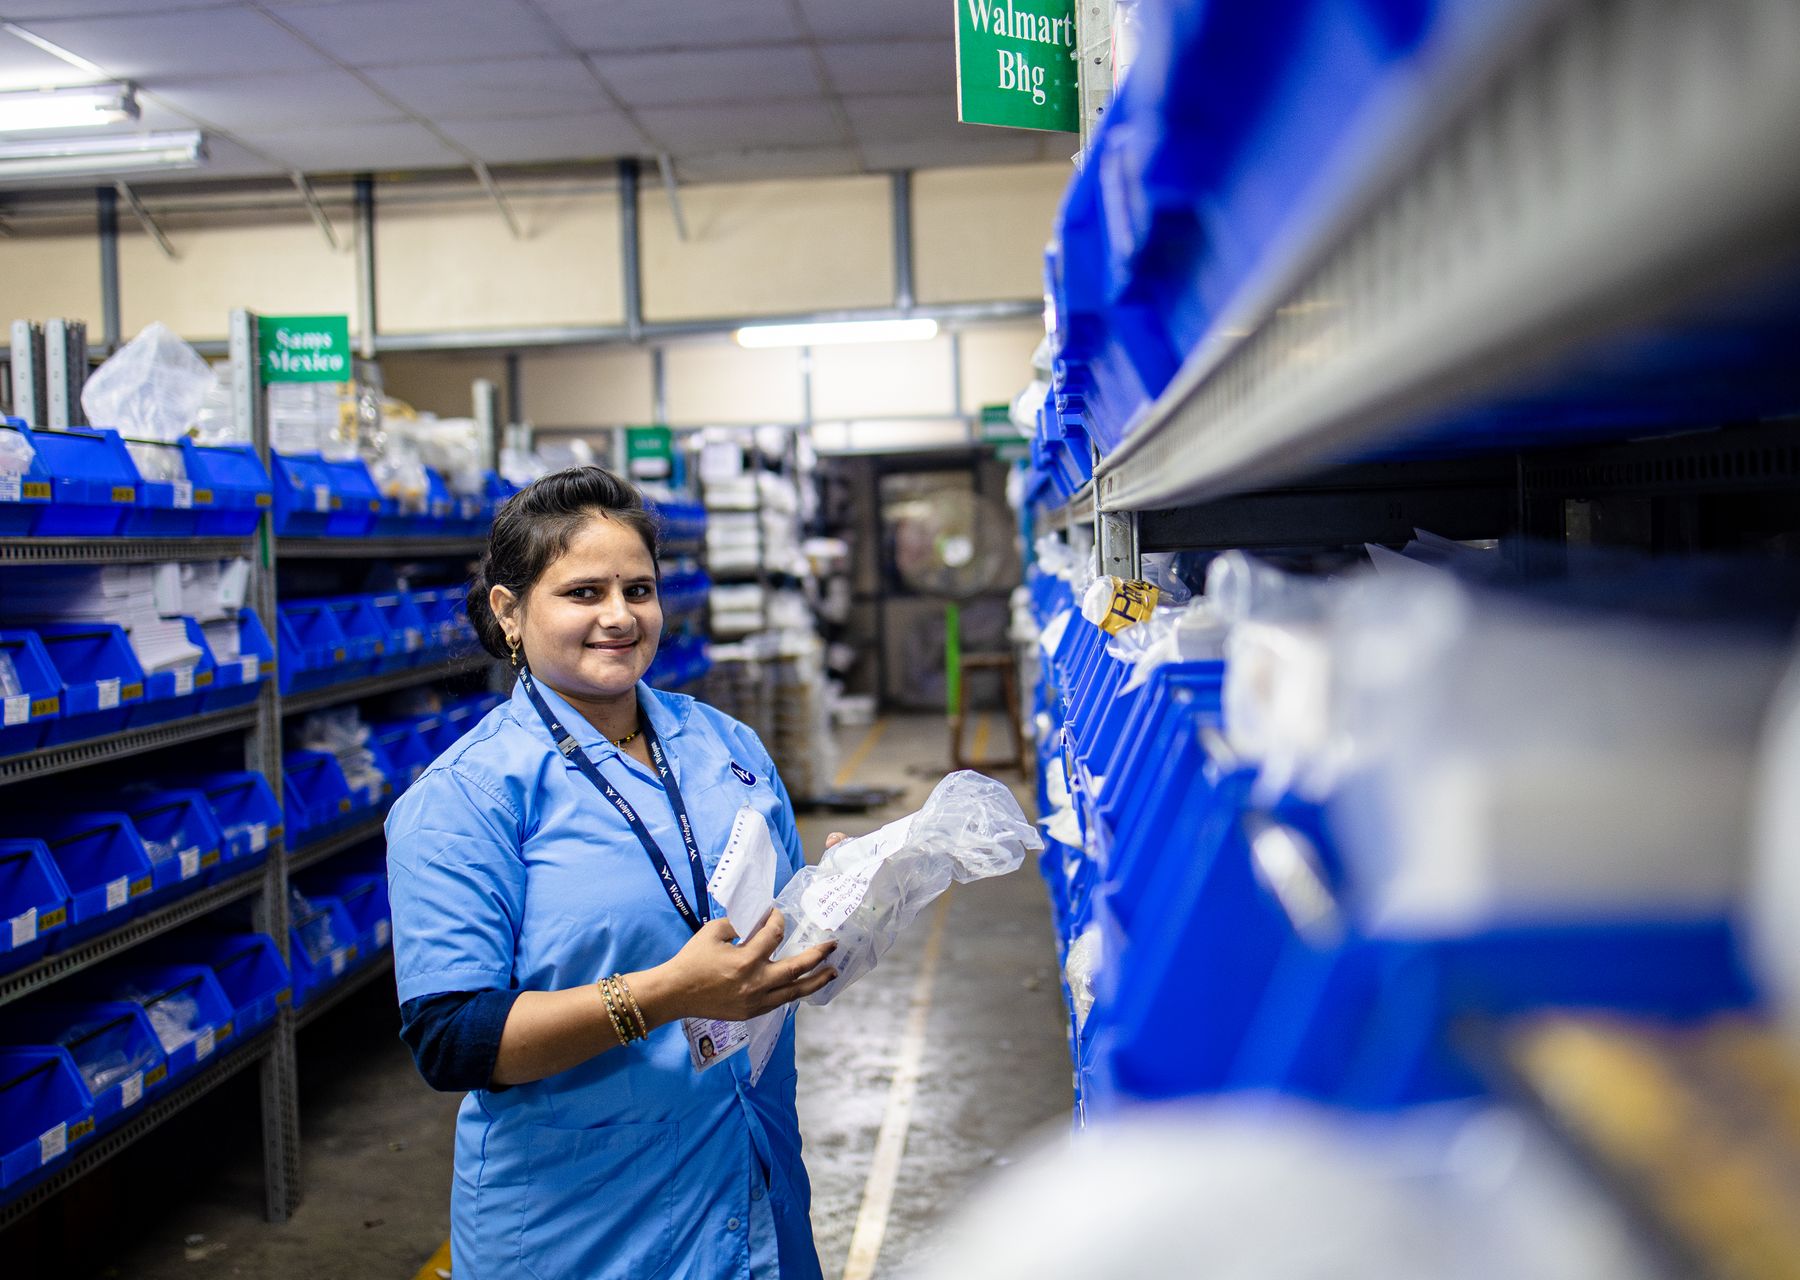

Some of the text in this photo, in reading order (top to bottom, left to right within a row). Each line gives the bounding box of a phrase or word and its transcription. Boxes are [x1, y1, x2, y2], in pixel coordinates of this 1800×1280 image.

[967, 0, 1072, 47] Walmart
[996, 49, 1046, 105] Bhg
[276, 328, 333, 350] Sams
[268, 349, 344, 373] Mexico
[615, 797, 636, 823] Welspun
[680, 814, 693, 844] Welspun
[669, 883, 690, 916] Welspun
